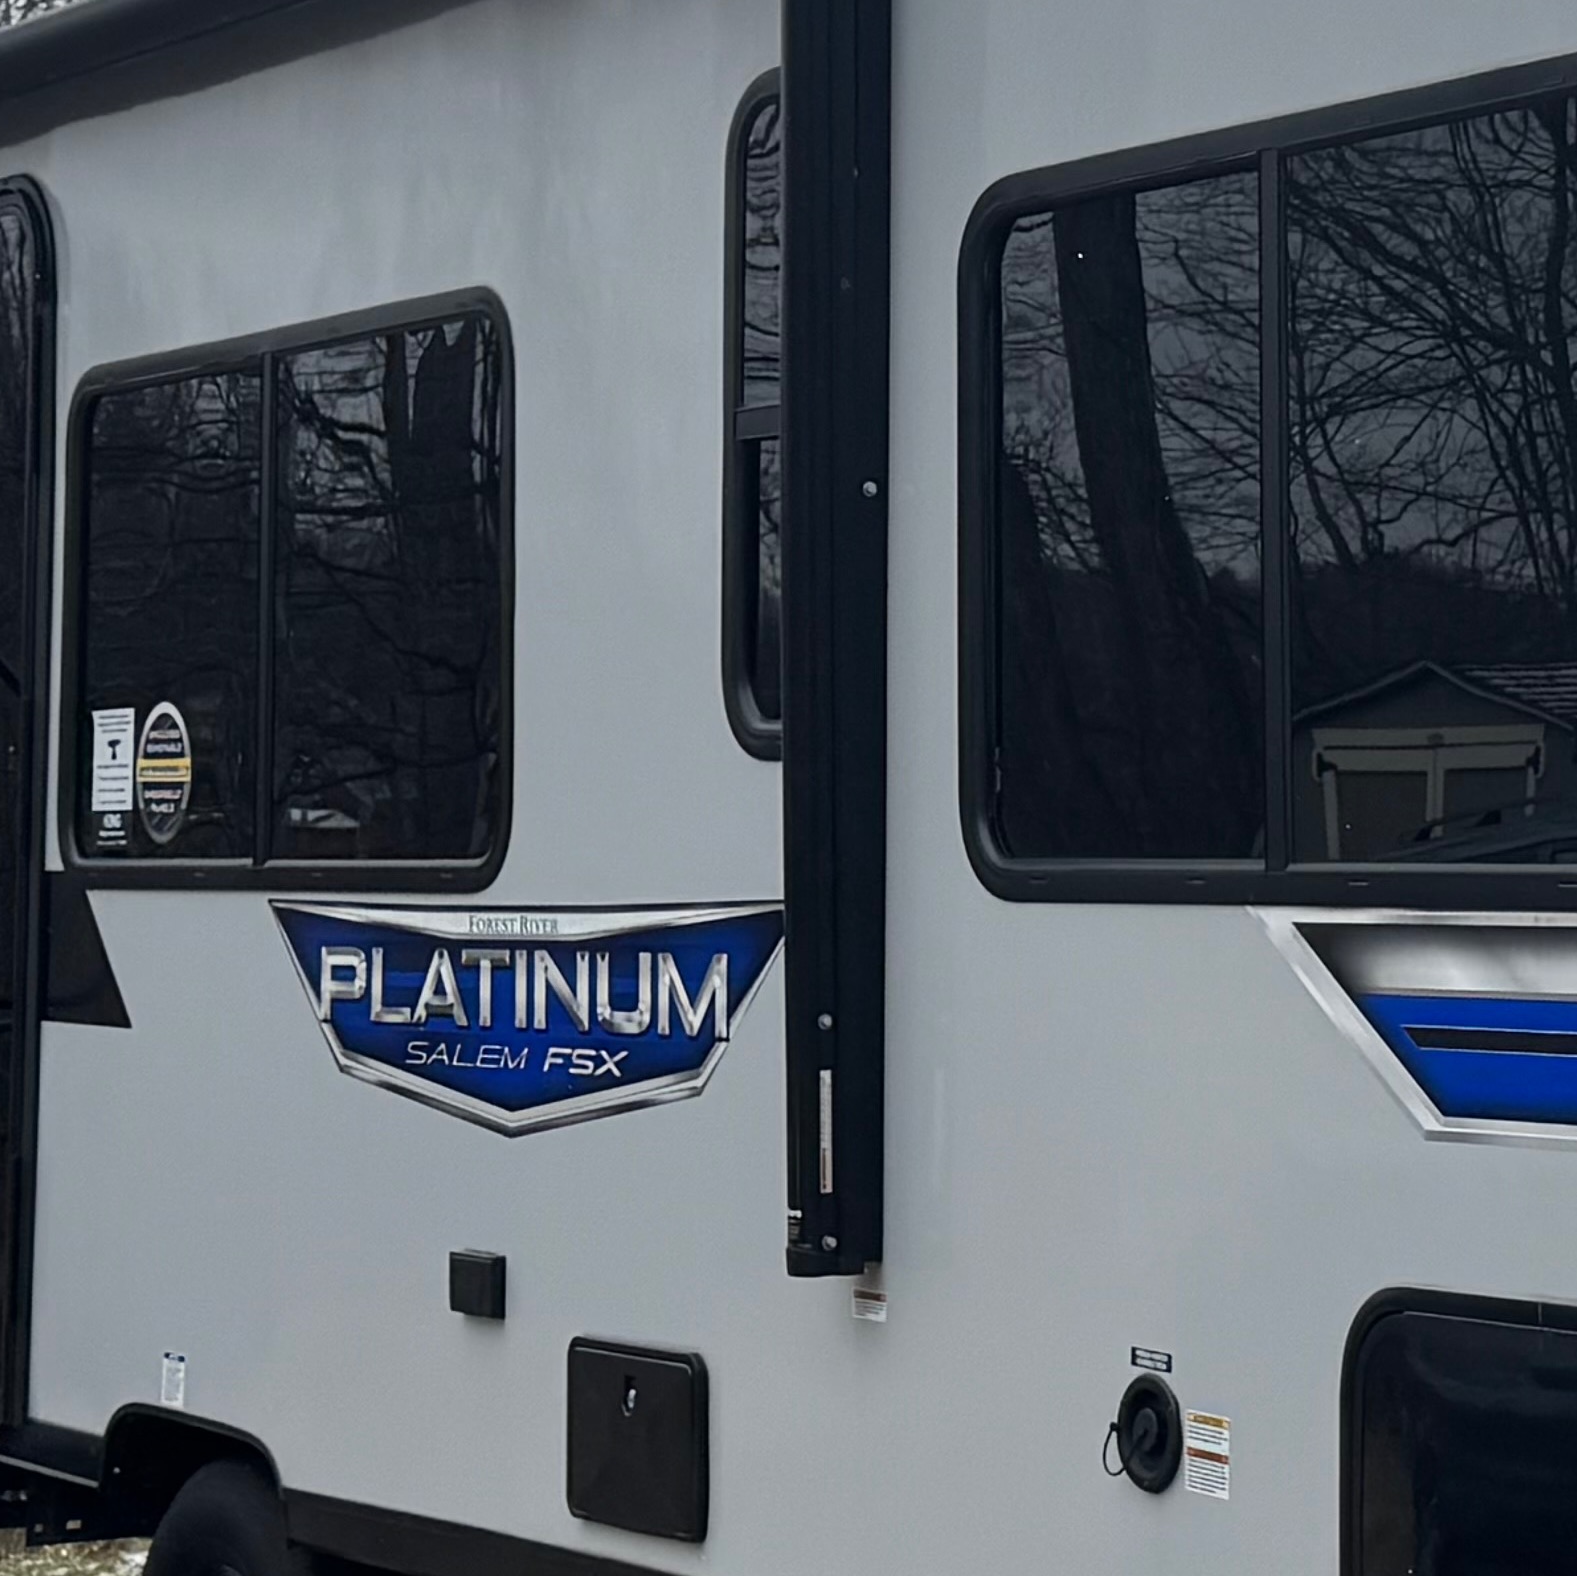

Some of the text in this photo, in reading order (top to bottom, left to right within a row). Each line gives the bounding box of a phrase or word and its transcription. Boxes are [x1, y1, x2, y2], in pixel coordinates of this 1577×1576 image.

[469, 914, 558, 935] FOREST RIVER
[319, 945, 729, 1042] PLATINUM
[405, 1041, 626, 1077] SALEM FSX
